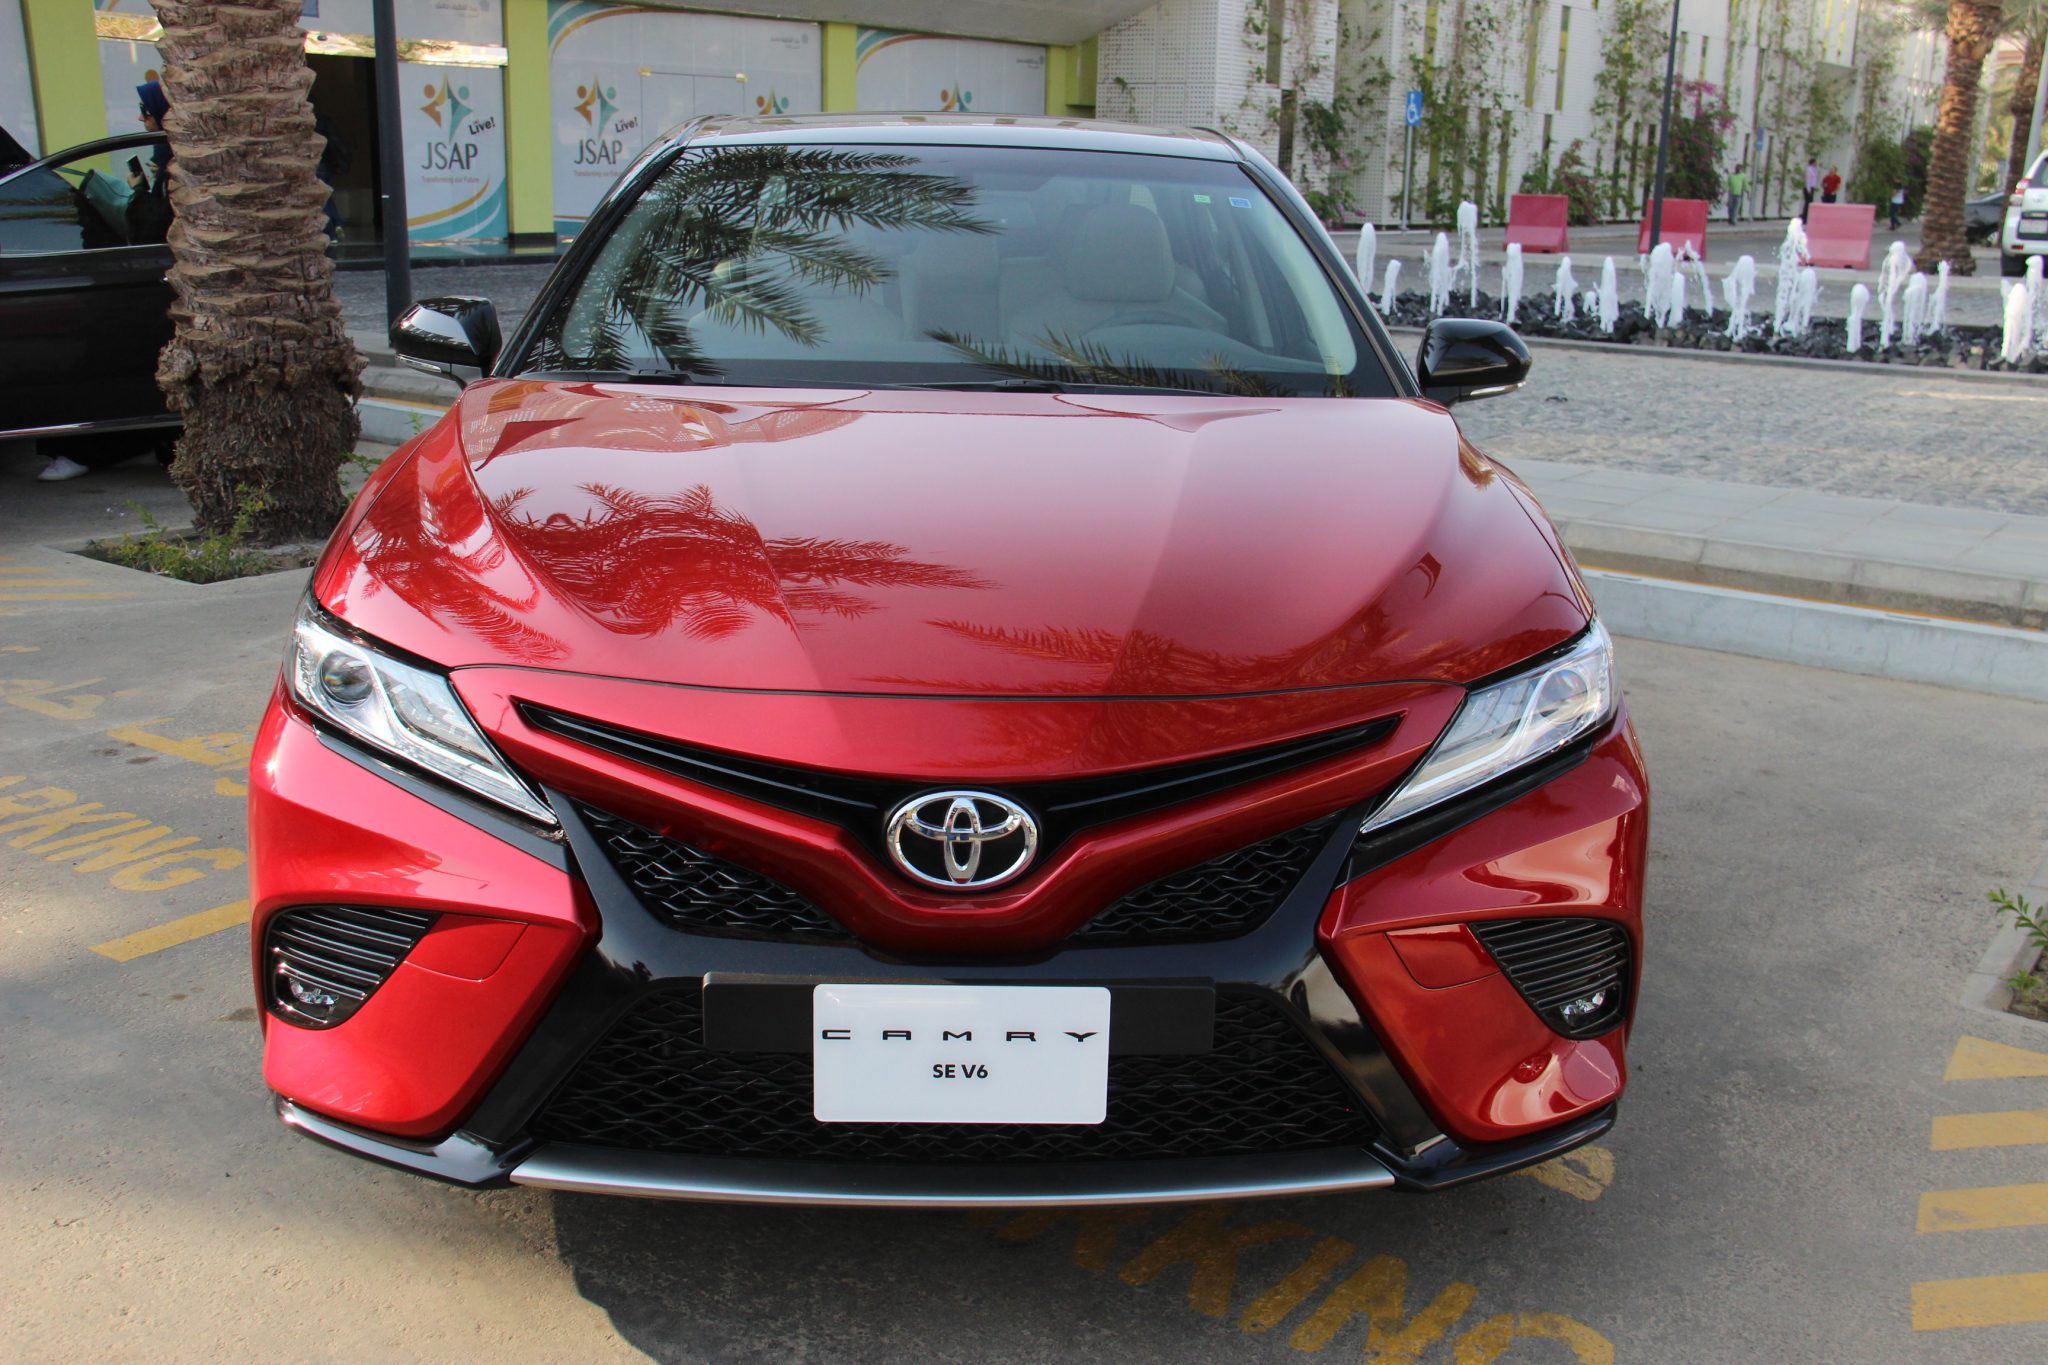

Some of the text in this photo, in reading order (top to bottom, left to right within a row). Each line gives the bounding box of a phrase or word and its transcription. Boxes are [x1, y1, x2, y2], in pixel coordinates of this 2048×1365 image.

[468, 116, 496, 135] Live!
[615, 116, 638, 133] Live!
[421, 142, 479, 170] JSAP
[574, 138, 623, 165] JSAP
[0, 775, 247, 890] RKING
[821, 1029, 1100, 1043] CAMRY
[932, 1063, 989, 1079] SE V6
